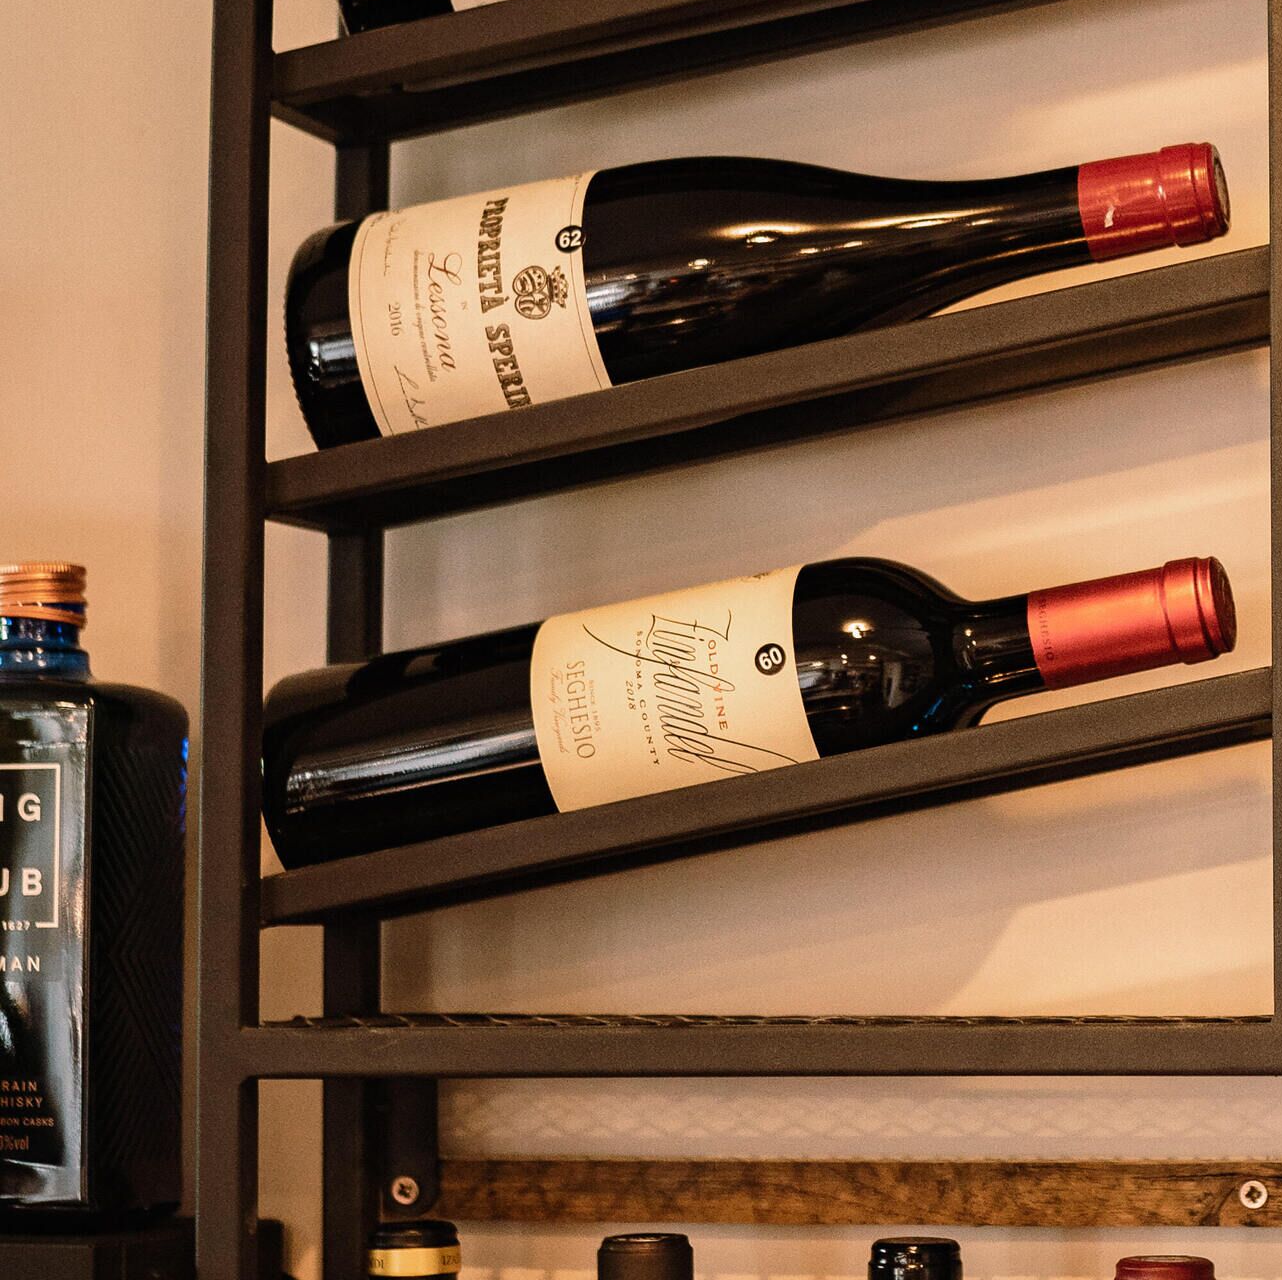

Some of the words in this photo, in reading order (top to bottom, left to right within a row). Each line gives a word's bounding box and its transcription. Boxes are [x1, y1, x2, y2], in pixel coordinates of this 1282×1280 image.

[477, 197, 510, 314] PROPRIETÀ
[559, 231, 582, 247] 62
[386, 302, 405, 337] 2016
[427, 252, 463, 370] Lessona
[626, 681, 637, 711] 2018
[635, 631, 645, 691] SONOMA
[640, 700, 660, 766] COUNTY
[707, 640, 719, 675] OLD
[713, 682, 728, 731] VINE
[759, 648, 782, 670] 60
[567, 660, 597, 759] SEGHESIO
